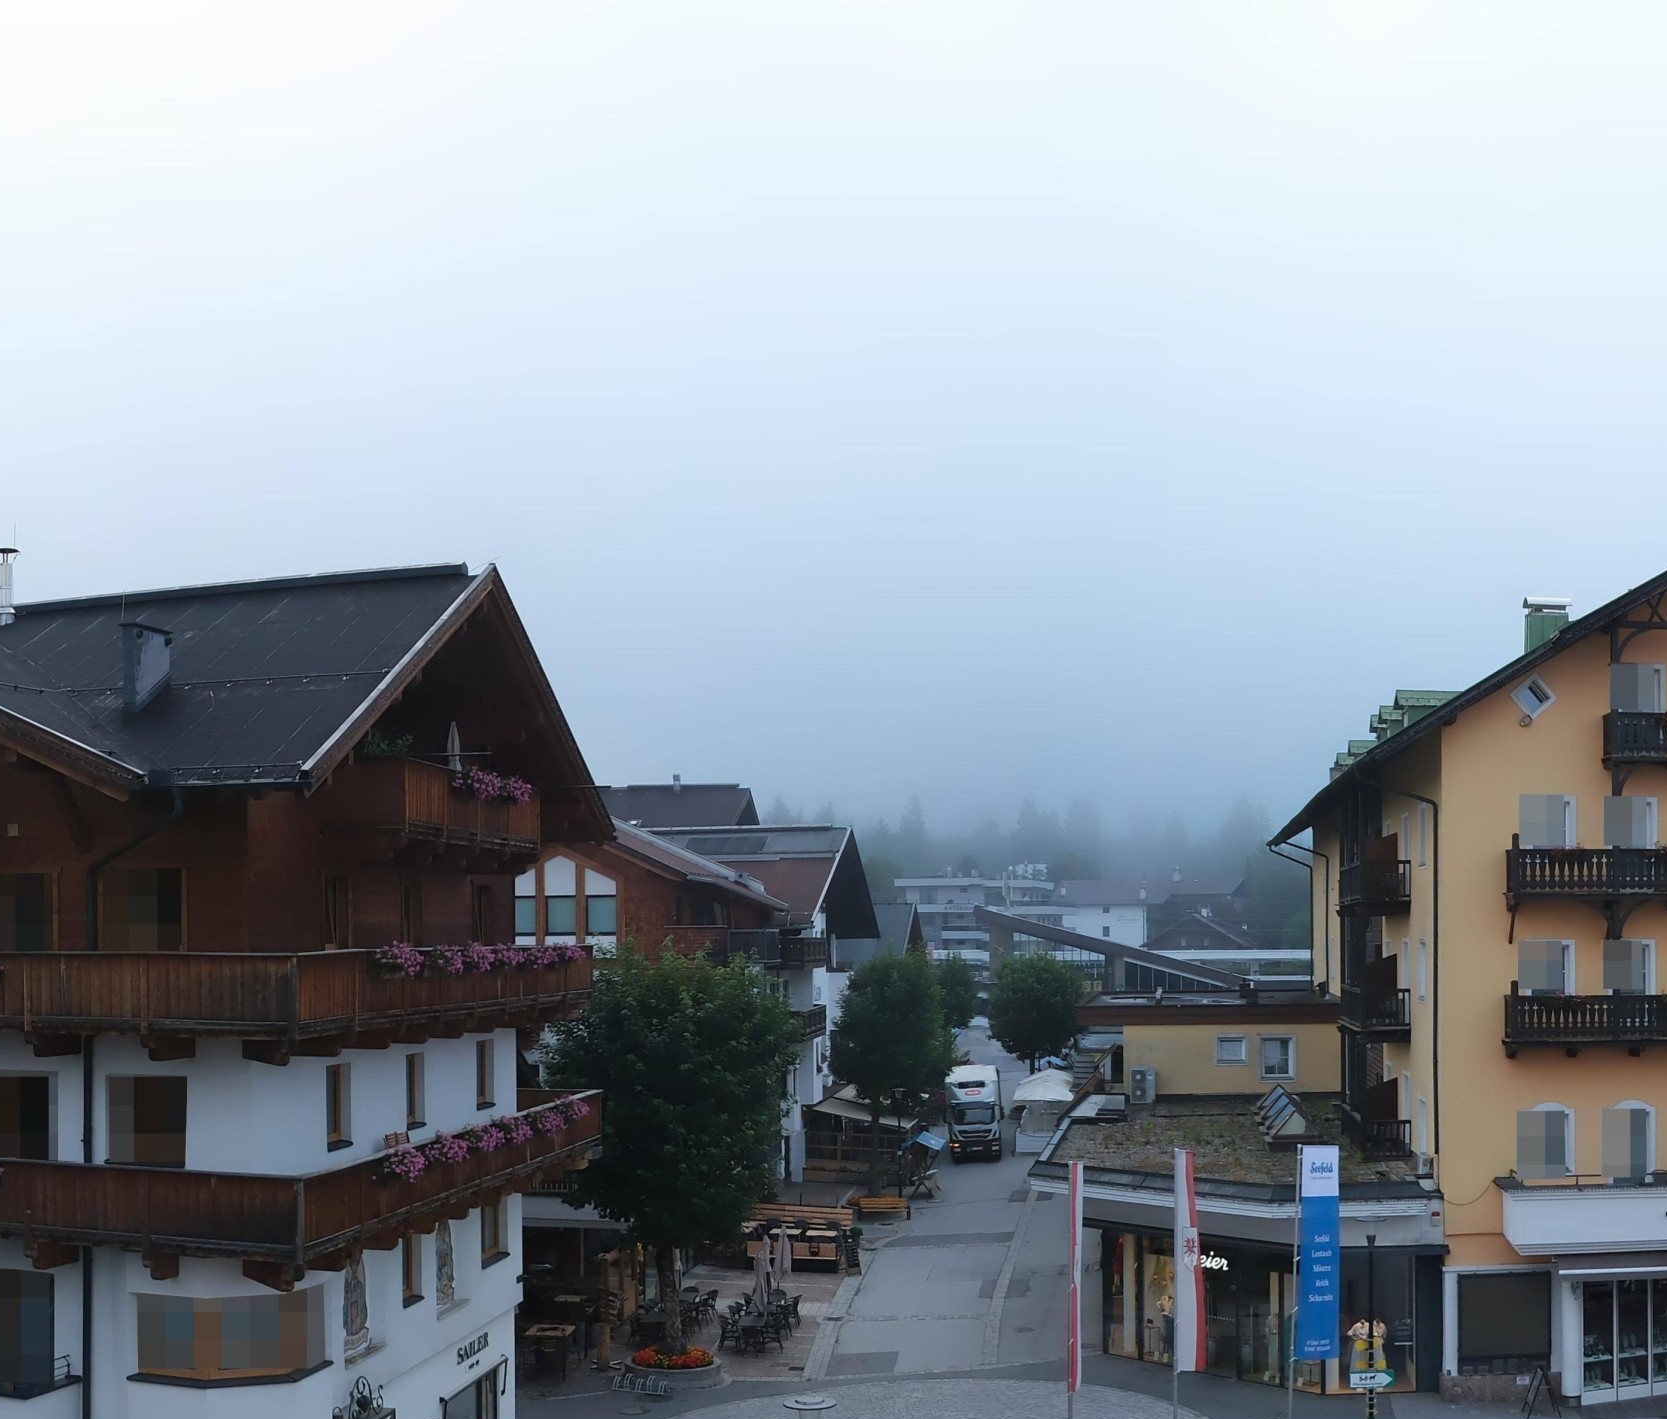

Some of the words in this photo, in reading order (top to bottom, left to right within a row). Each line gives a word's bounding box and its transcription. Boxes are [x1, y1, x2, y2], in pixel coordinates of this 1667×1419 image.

[1310, 1162, 1333, 1174] Seefeld
[1200, 1251, 1229, 1271] eier
[456, 1332, 489, 1366] SAILER
